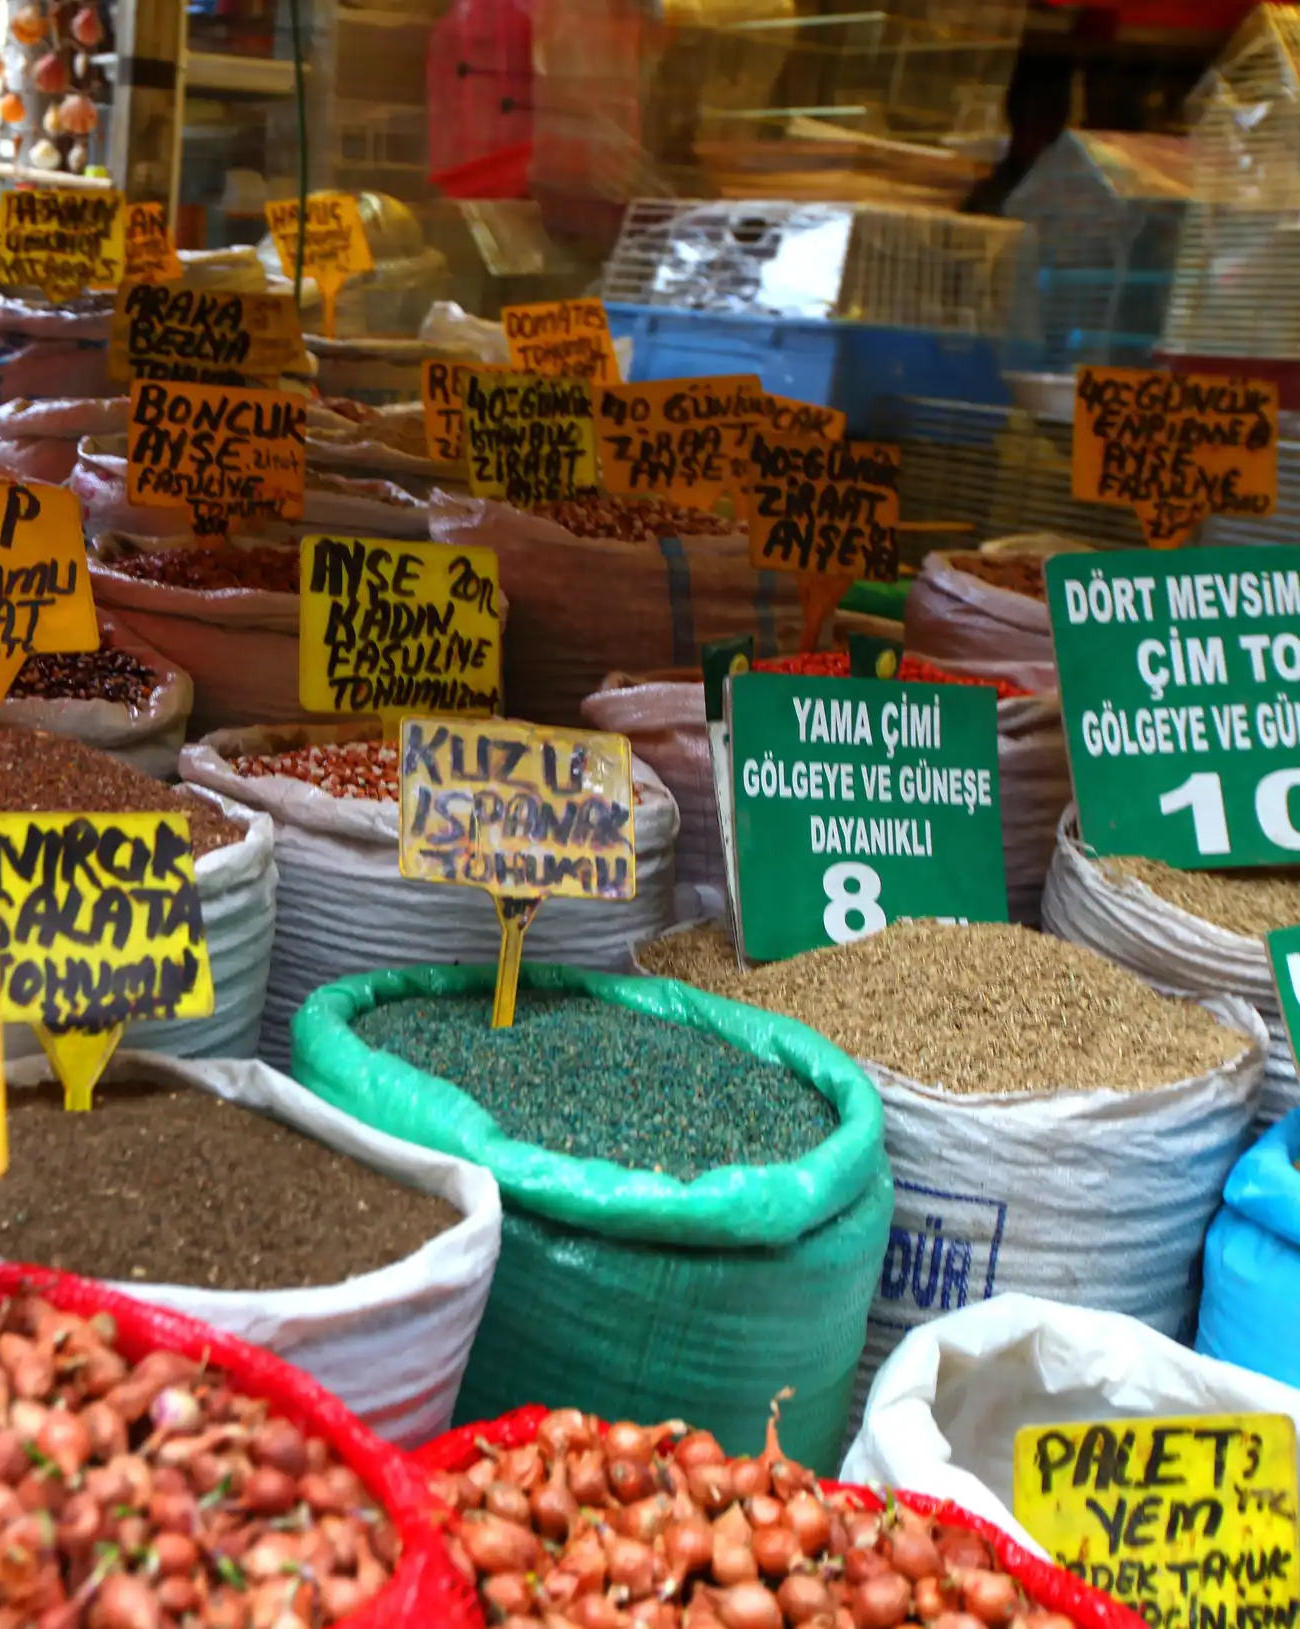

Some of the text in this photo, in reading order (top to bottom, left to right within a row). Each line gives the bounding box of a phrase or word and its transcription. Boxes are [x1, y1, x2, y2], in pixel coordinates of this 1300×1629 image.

[133, 383, 306, 444] BONCUK
[324, 601, 455, 653] KADIN
[1064, 568, 1300, 625] DÖRT MEVSİM
[1137, 626, 1300, 700] ÇİM TO
[793, 692, 942, 758] YAMA ÇİMİ
[1082, 691, 1300, 757] GÖLGEYE VE GÜ
[404, 723, 589, 795] KUZU
[743, 750, 992, 815] GÖLGEYE VE GÜNEŞE
[411, 785, 635, 850] ISPANAK
[810, 815, 933, 857] DAYANIKLI
[418, 847, 628, 892] TOHUMU
[822, 861, 887, 945] 8
[1035, 1424, 1242, 1494] PALET
[1086, 1497, 1226, 1555] YEM
